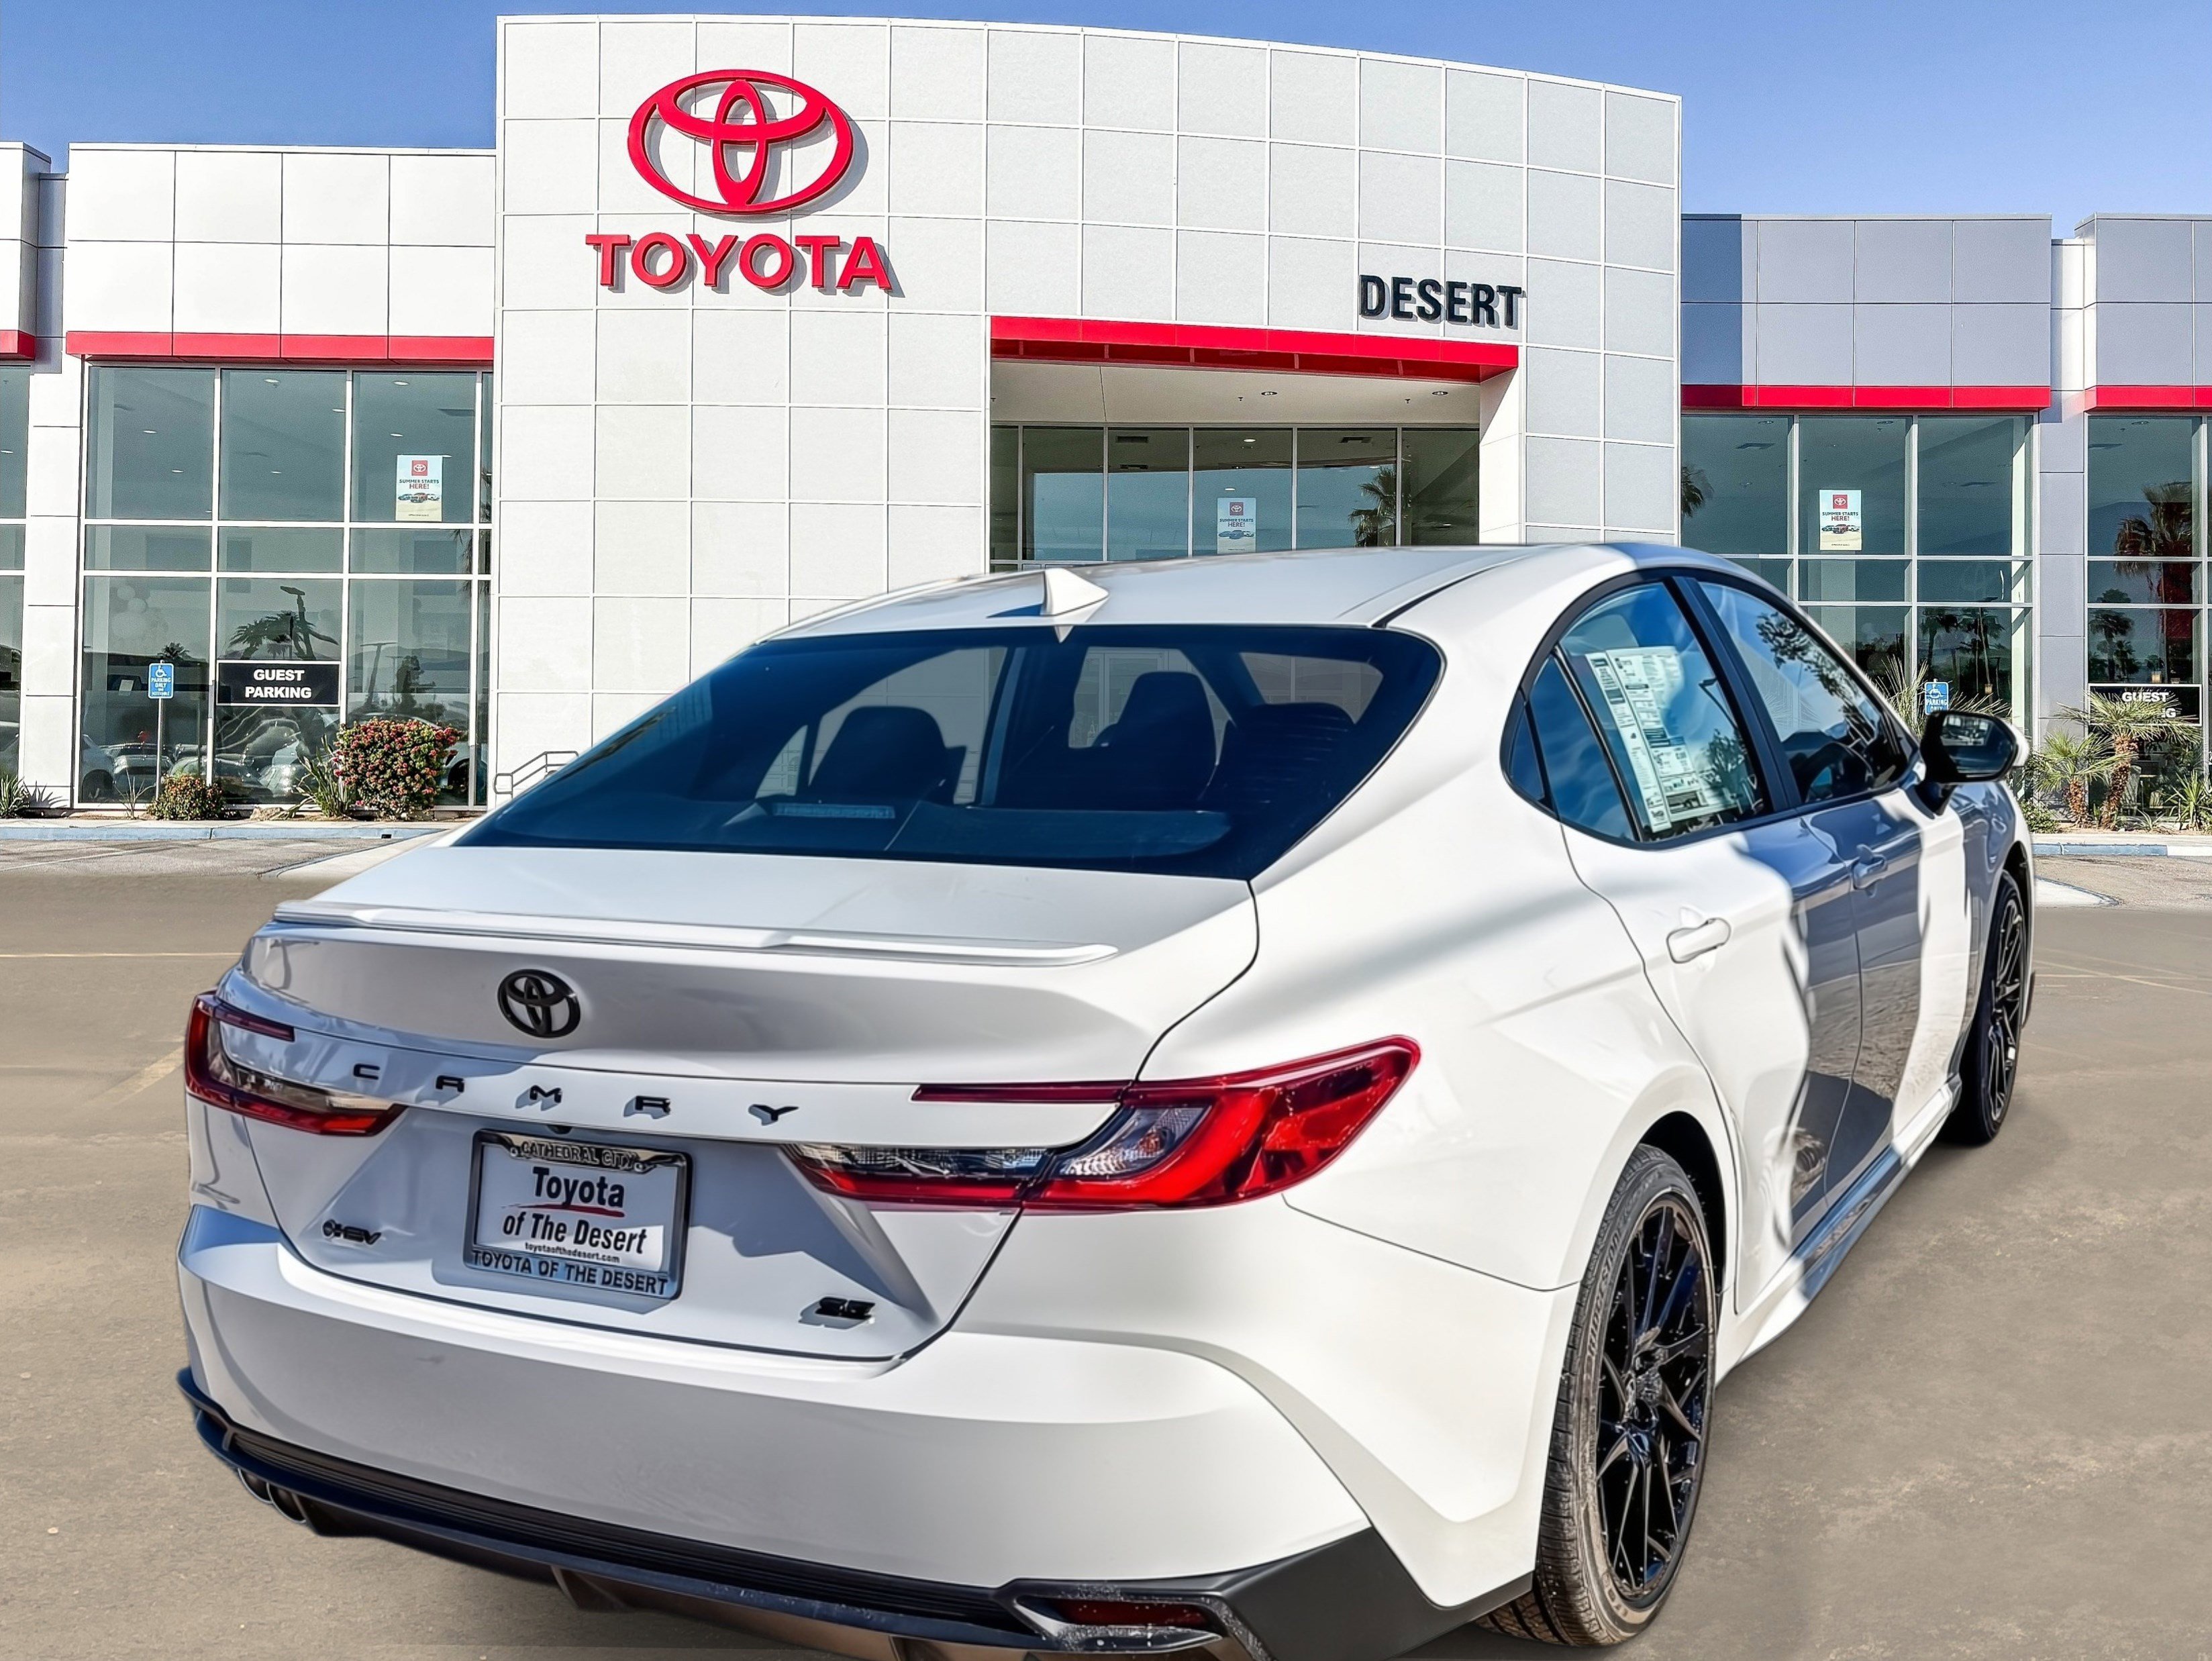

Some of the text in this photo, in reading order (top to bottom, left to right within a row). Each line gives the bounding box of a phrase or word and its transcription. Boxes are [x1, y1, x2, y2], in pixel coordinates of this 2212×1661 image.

[586, 232, 894, 291] TOYOTA
[1359, 274, 1522, 327] DESERT
[245, 686, 312, 699] PARKING
[253, 669, 305, 681] GUEST
[2121, 691, 2169, 702] GUEST
[354, 1063, 799, 1123] CAMRY
[521, 1141, 638, 1170] CATHEDRAL CITY
[532, 1166, 625, 1208] Toyota
[503, 1211, 647, 1254] of The Desert
[525, 1242, 620, 1263] toyotaofthedesert.com
[472, 1250, 668, 1295] TOYOTA OF THE DESERT
